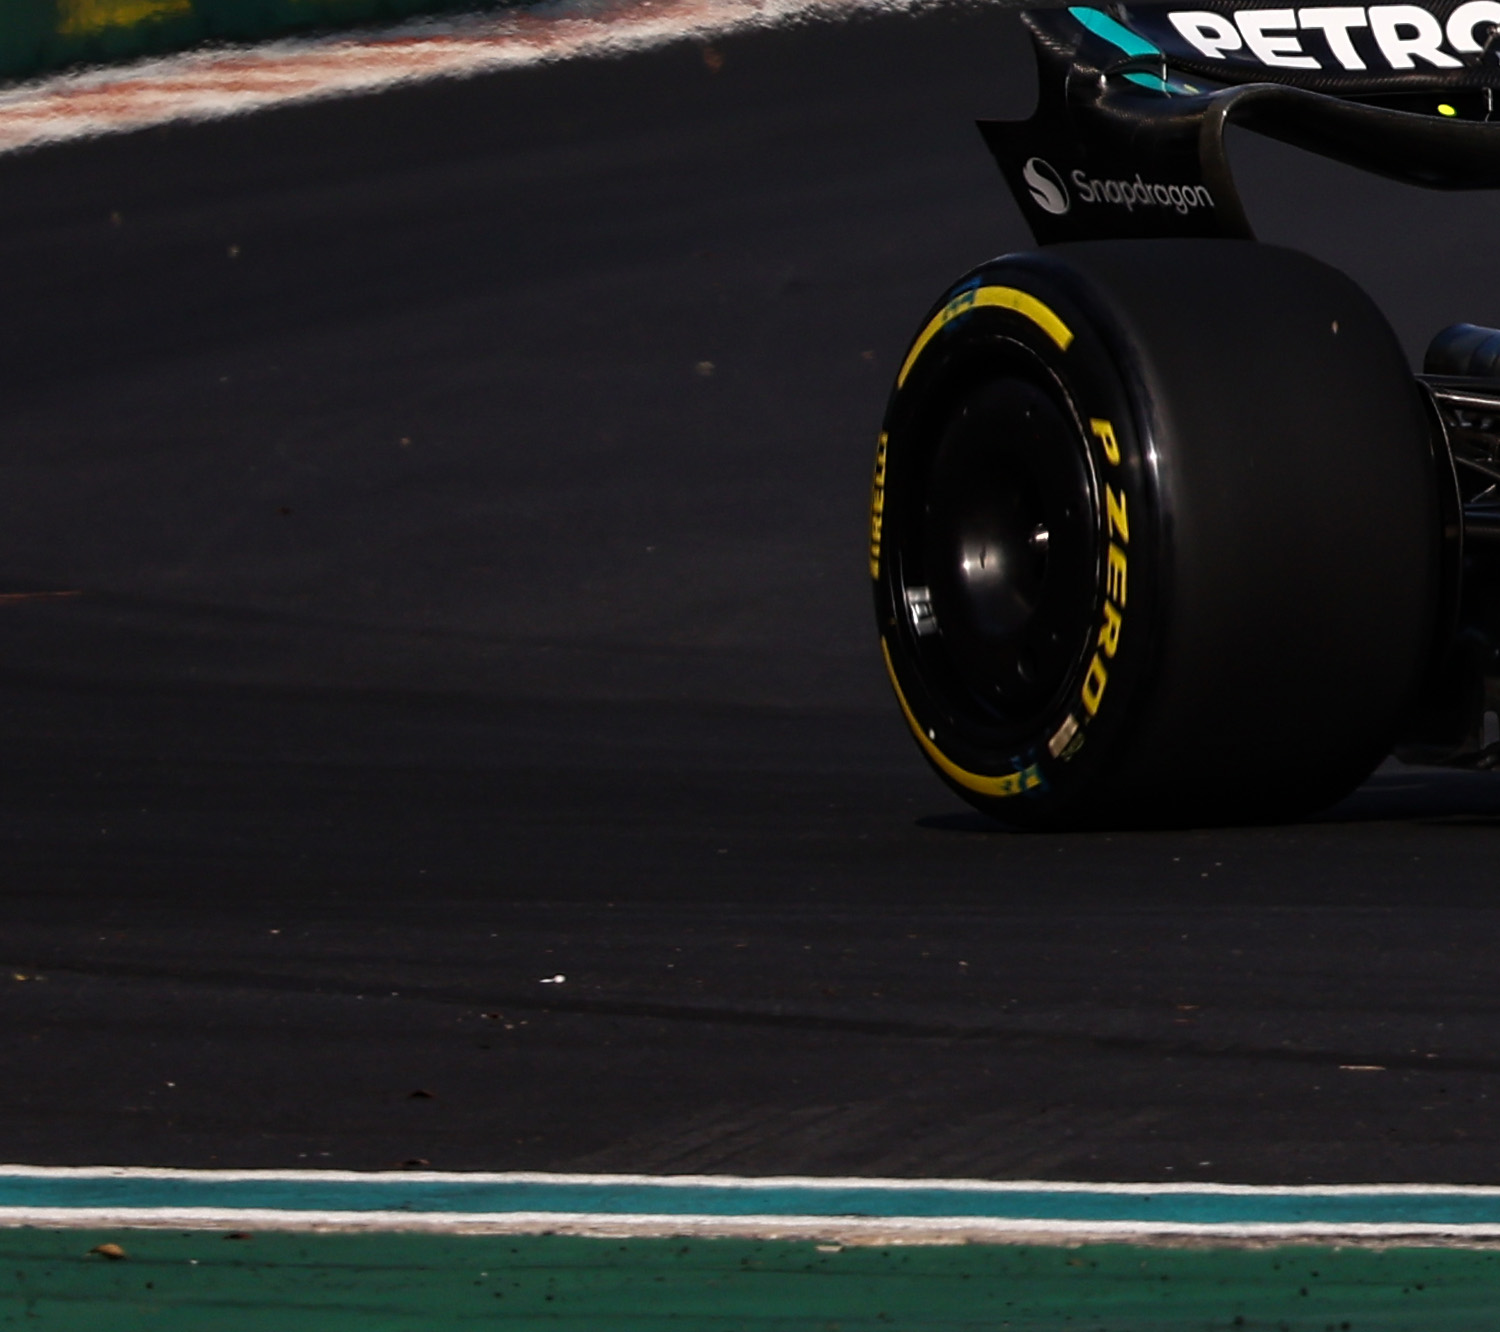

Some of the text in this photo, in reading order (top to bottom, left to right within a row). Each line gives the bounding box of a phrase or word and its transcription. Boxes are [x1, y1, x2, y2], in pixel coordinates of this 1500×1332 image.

[1075, 167, 1215, 218] Snapdragon
[1080, 418, 1130, 717] P ZERO
